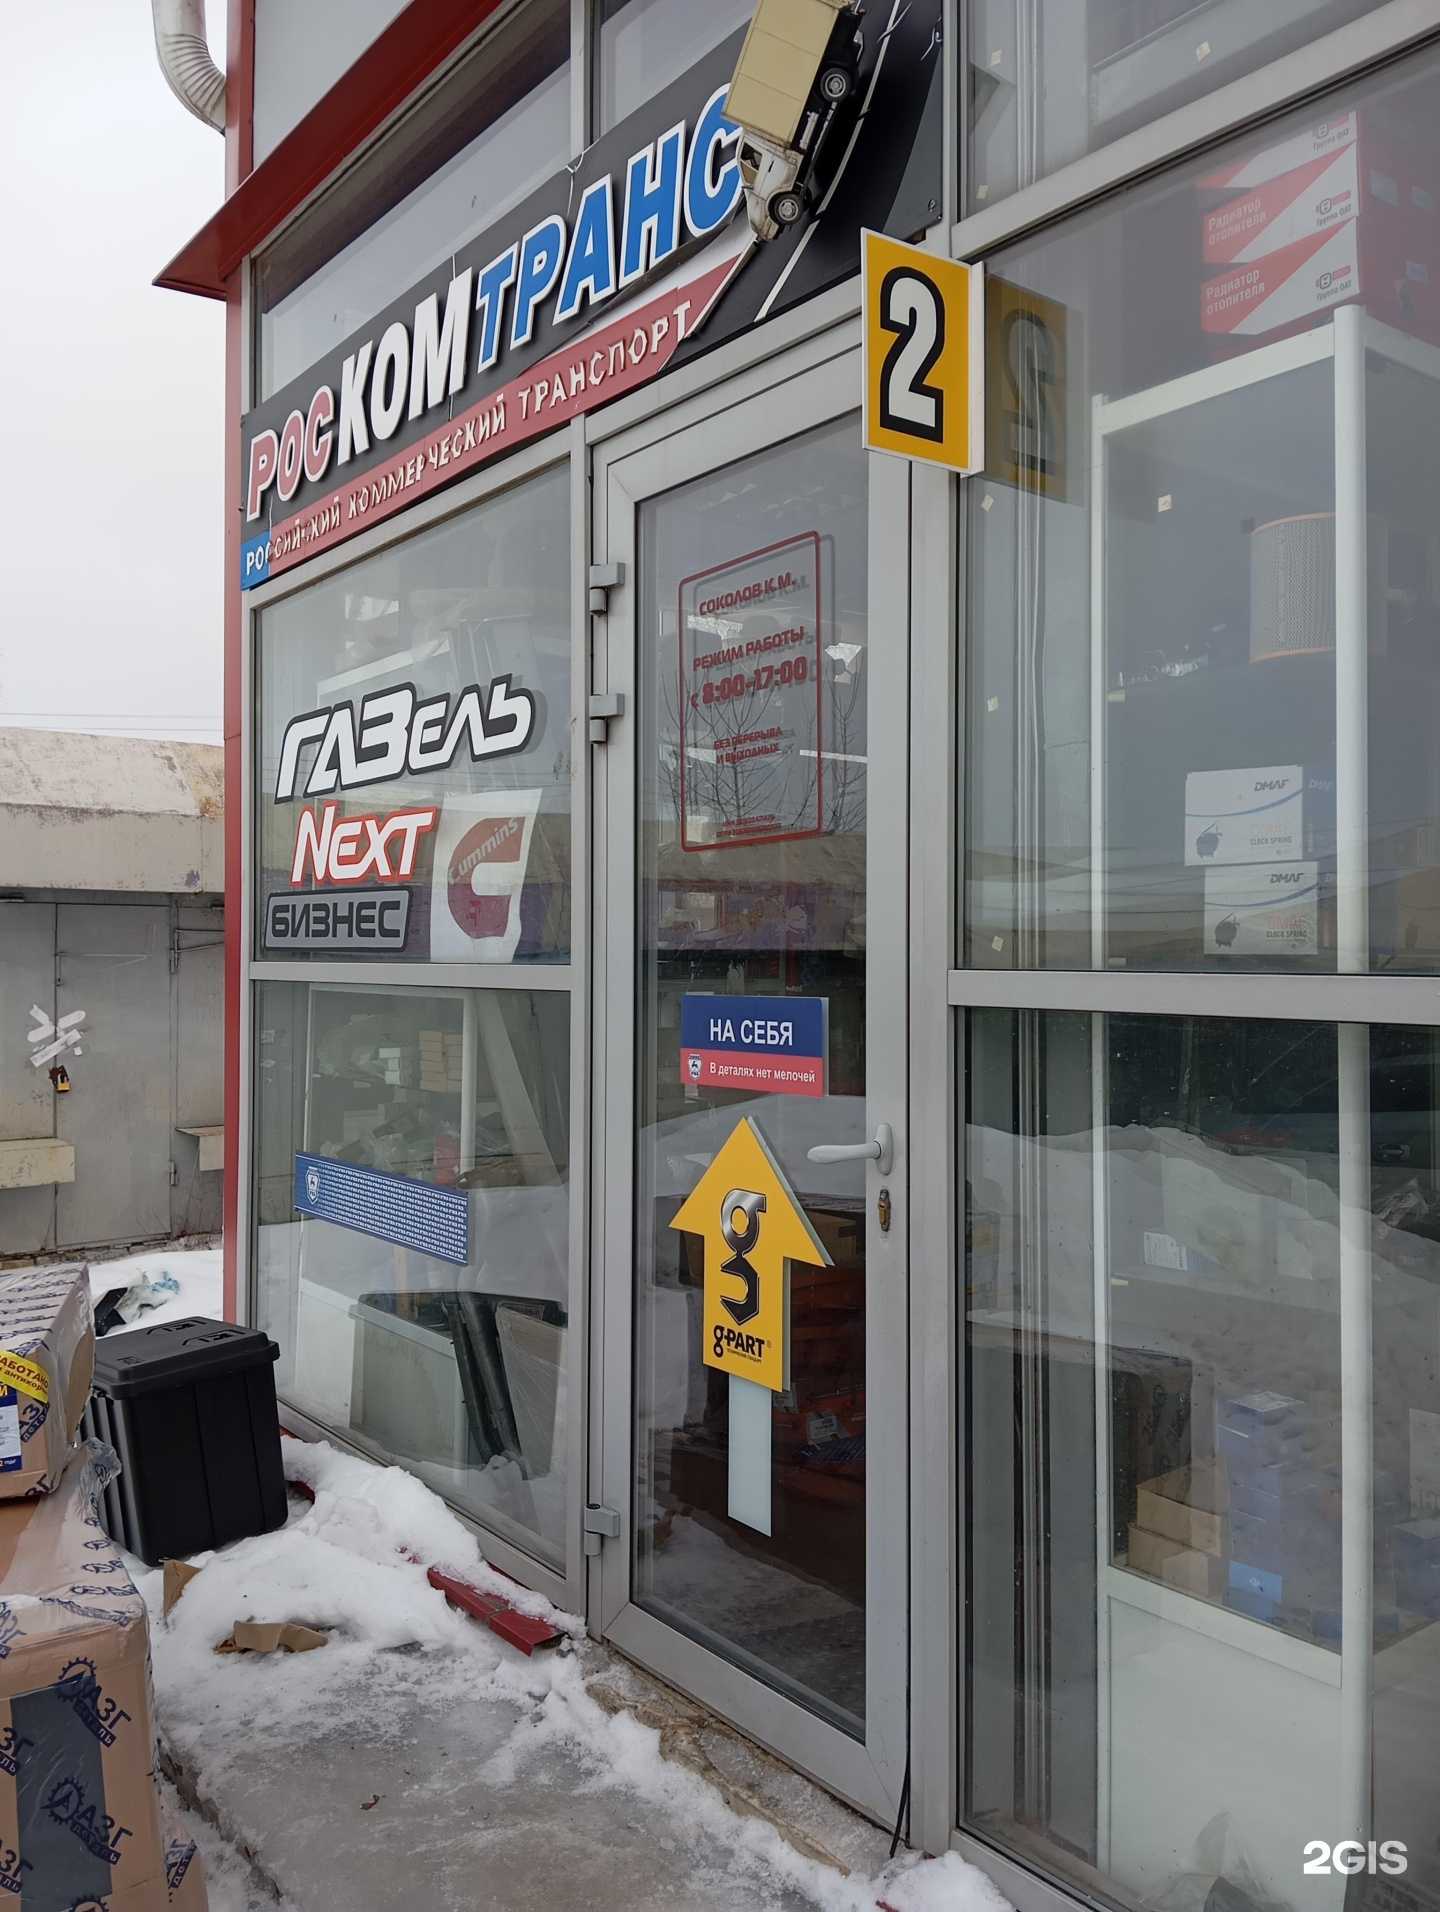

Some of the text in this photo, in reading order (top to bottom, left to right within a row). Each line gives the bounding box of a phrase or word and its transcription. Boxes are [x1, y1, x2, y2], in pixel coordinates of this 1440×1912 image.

[1206, 270, 1260, 298] Радиатор
[1207, 282, 1265, 315] отопителя
[247, 83, 743, 522] РОСКОМТРАНС
[879, 266, 945, 444] 2
[348, 393, 507, 520] КОММЕРЧЕСКИЙ
[518, 299, 692, 421] ТРАНСПОРТ
[699, 582, 763, 616] СОКОЛОВ
[693, 626, 805, 672] РЕЖИМ РАБОТЫ
[714, 726, 783, 750] БЕЗ ПЕРЕРЫВА
[271, 900, 401, 938] БИЗНЕС
[710, 1018, 793, 1046] НА СЕБЯ
[709, 1062, 717, 1074] В
[718, 1065, 754, 1078] деталях
[756, 1067, 772, 1079] нет
[774, 1069, 816, 1083] мелочей
